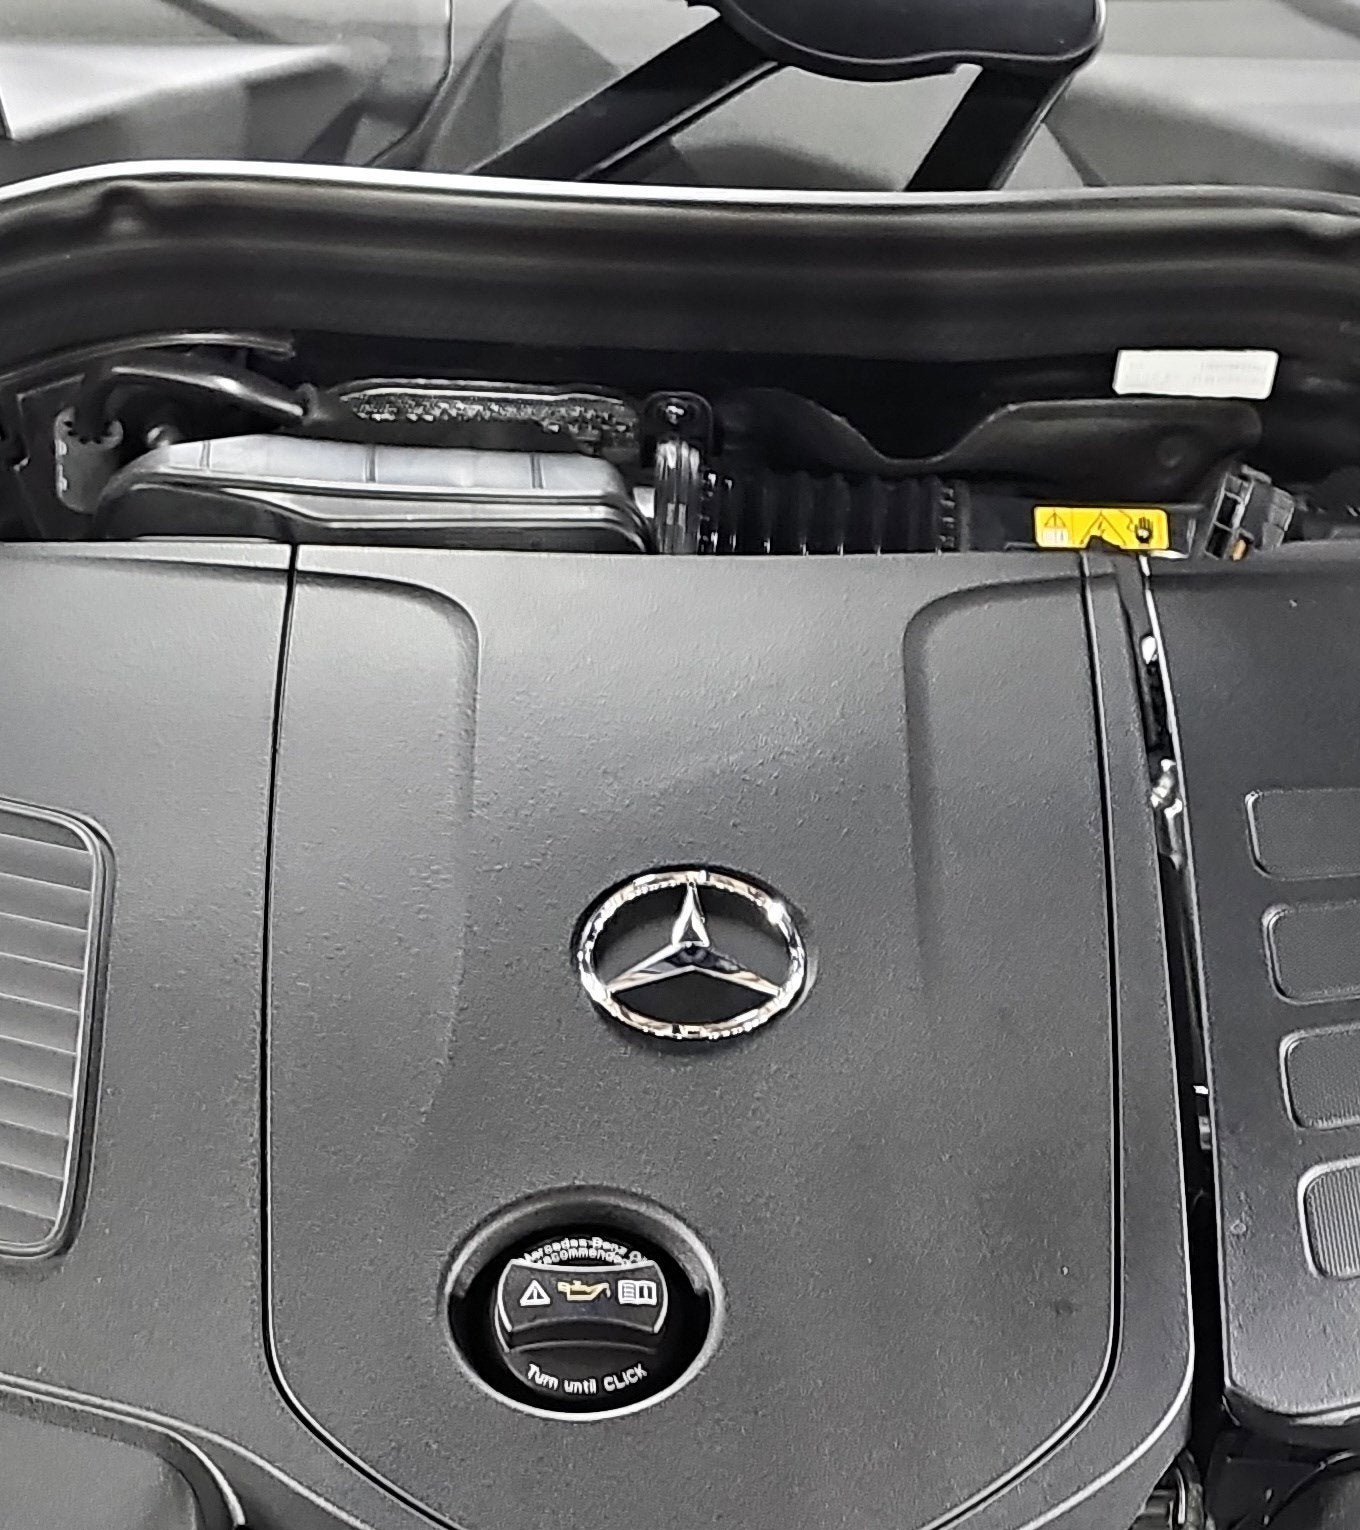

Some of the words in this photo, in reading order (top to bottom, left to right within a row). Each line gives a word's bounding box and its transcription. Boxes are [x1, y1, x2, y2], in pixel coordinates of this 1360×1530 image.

[527, 1363, 559, 1391] Turn
[563, 1378, 597, 1394] until
[603, 1363, 648, 1392] CLICK
